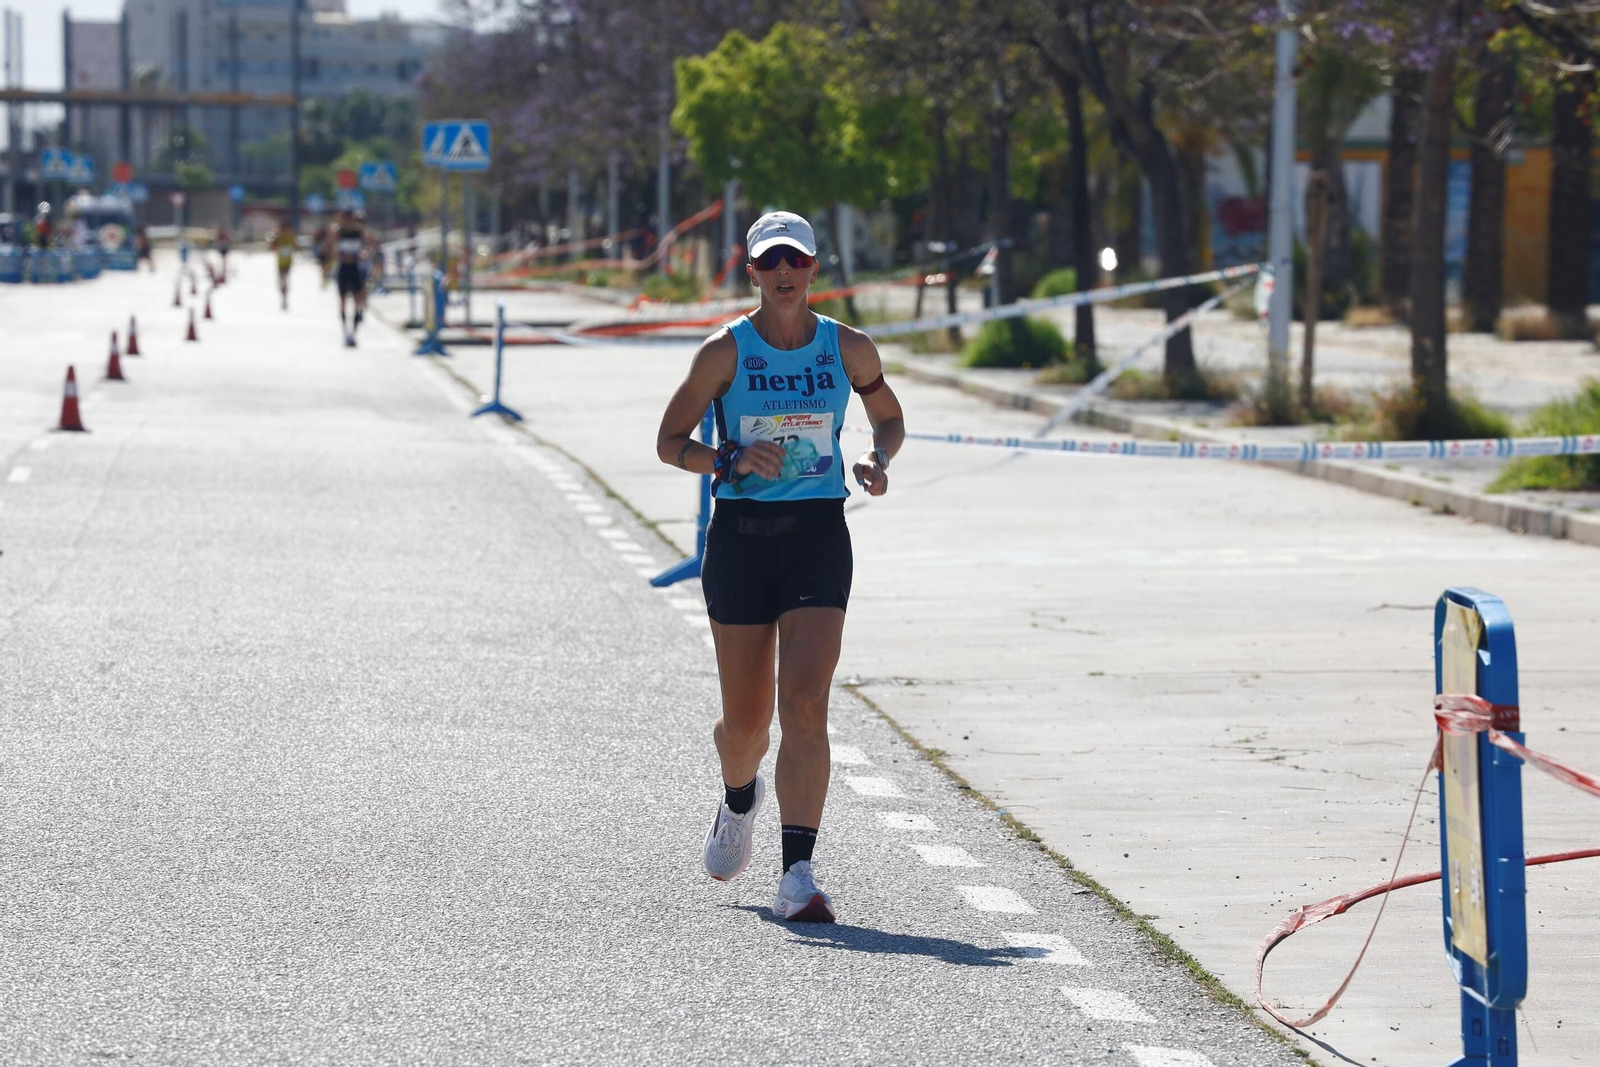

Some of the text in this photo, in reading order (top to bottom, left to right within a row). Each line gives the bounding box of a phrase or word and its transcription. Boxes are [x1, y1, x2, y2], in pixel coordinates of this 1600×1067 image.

[744, 357, 767, 369] TROPS
[816, 350, 835, 364] als
[748, 367, 835, 396] nerja
[762, 399, 827, 411] ATLETISMO
[781, 420, 823, 428] ATLETISMO
